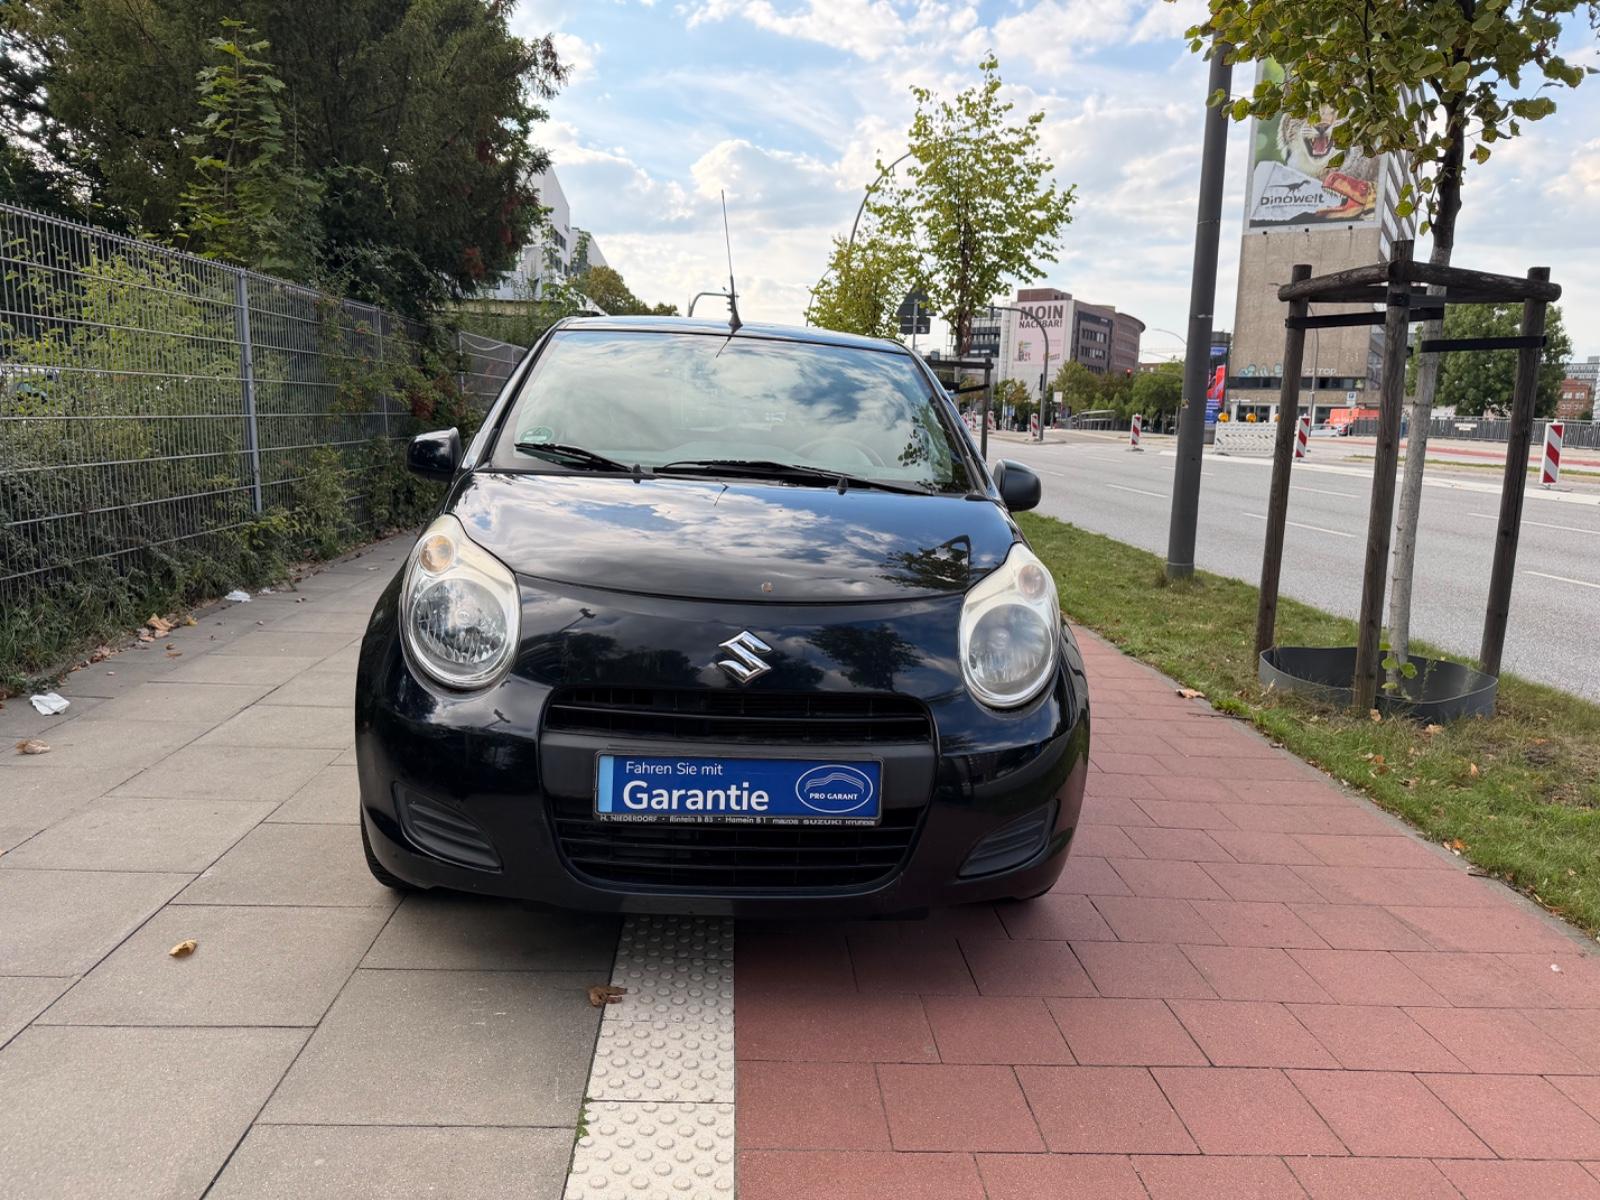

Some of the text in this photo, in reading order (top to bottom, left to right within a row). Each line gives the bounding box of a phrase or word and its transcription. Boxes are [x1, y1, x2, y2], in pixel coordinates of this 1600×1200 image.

[1260, 194, 1325, 206] Dinowelt
[1020, 305, 1064, 320] MOIN
[625, 761, 724, 776] Fahren Sie mit
[622, 780, 769, 811] Garantie
[809, 792, 858, 801] PRO GARANT
[610, 815, 657, 823] NIEDERDORF
